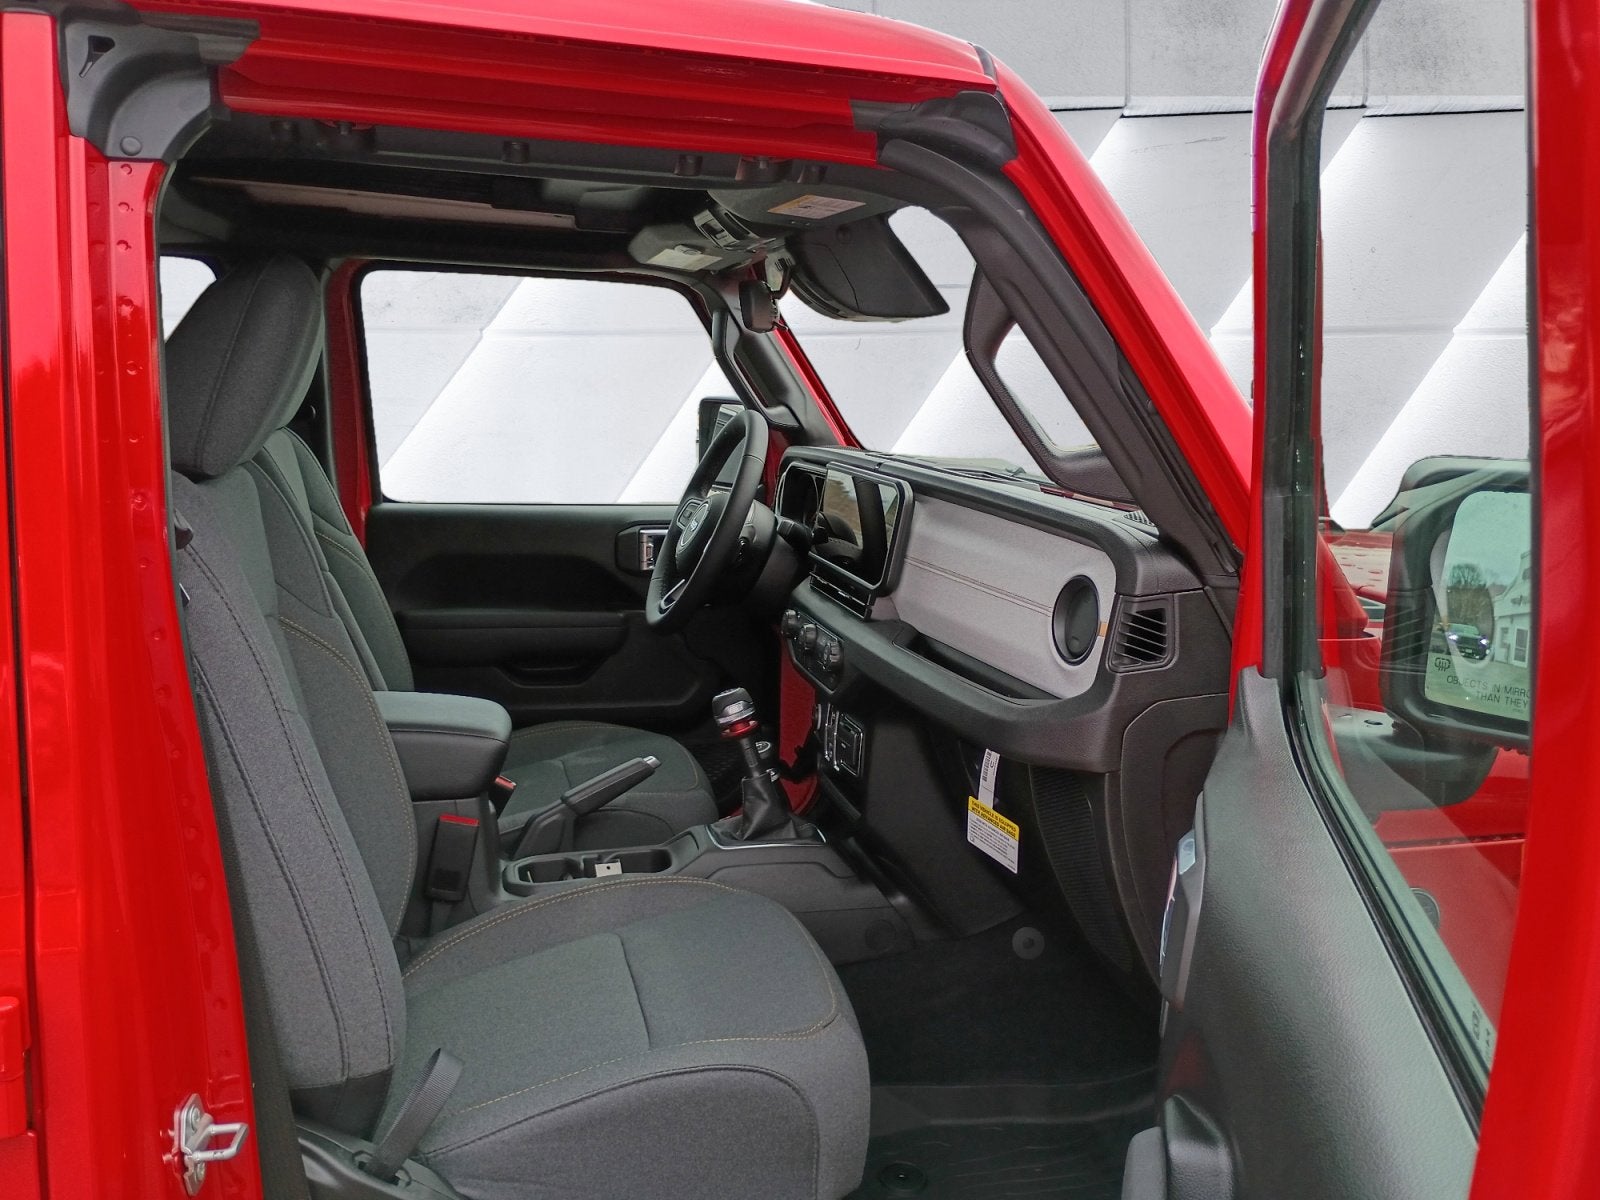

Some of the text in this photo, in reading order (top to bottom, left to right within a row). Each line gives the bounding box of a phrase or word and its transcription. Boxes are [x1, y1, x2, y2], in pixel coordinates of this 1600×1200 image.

[1446, 675, 1488, 690] OBJECTS
[1492, 684, 1500, 693] IN
[1476, 691, 1528, 708] THAN THEY
